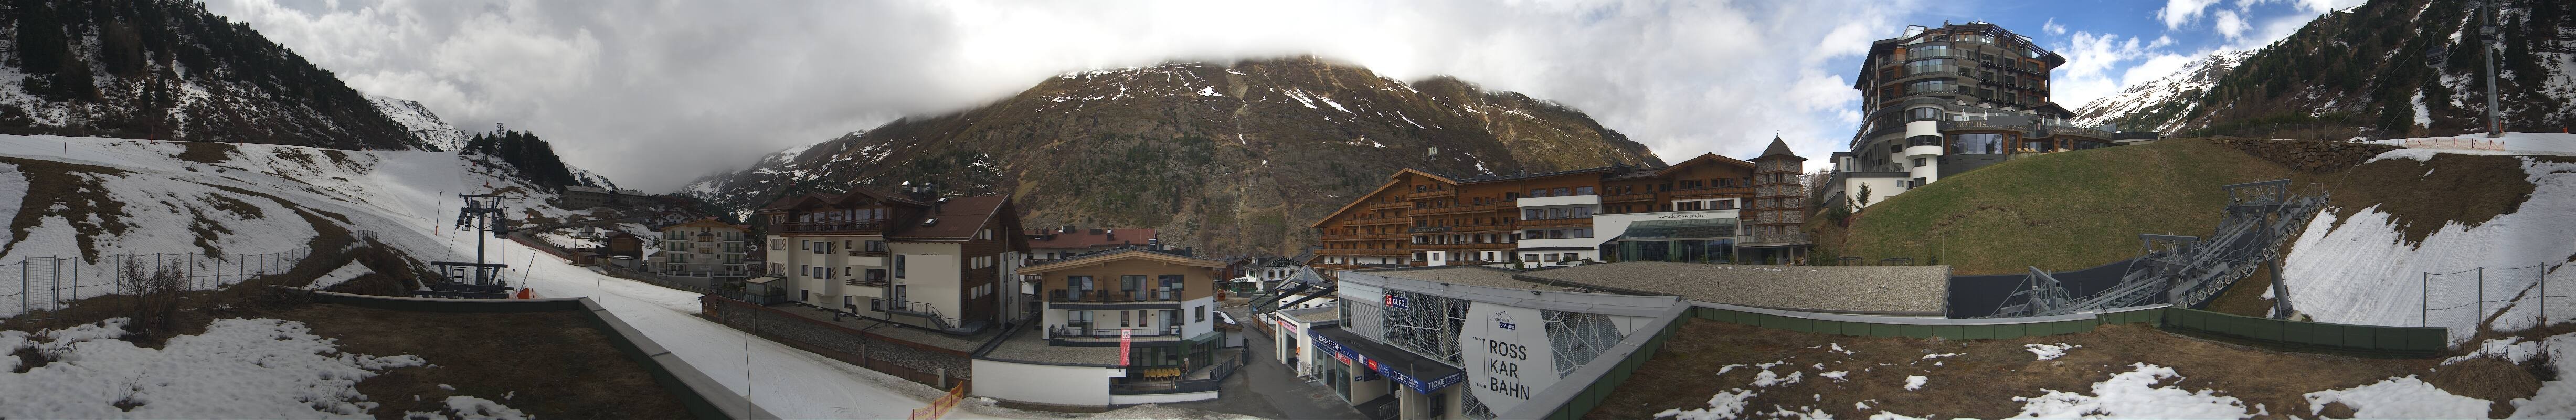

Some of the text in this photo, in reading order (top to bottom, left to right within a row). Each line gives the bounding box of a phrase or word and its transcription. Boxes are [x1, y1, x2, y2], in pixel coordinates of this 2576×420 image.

[1393, 298, 1407, 308] GURGL
[1319, 334, 1342, 352] ROSSKARBAHN
[1490, 339, 1526, 361] ROSS
[1393, 371, 1409, 384] TICKET
[1490, 358, 1518, 379] KAR
[1427, 376, 1448, 390] TICKET
[1491, 376, 1530, 400] BAHN
